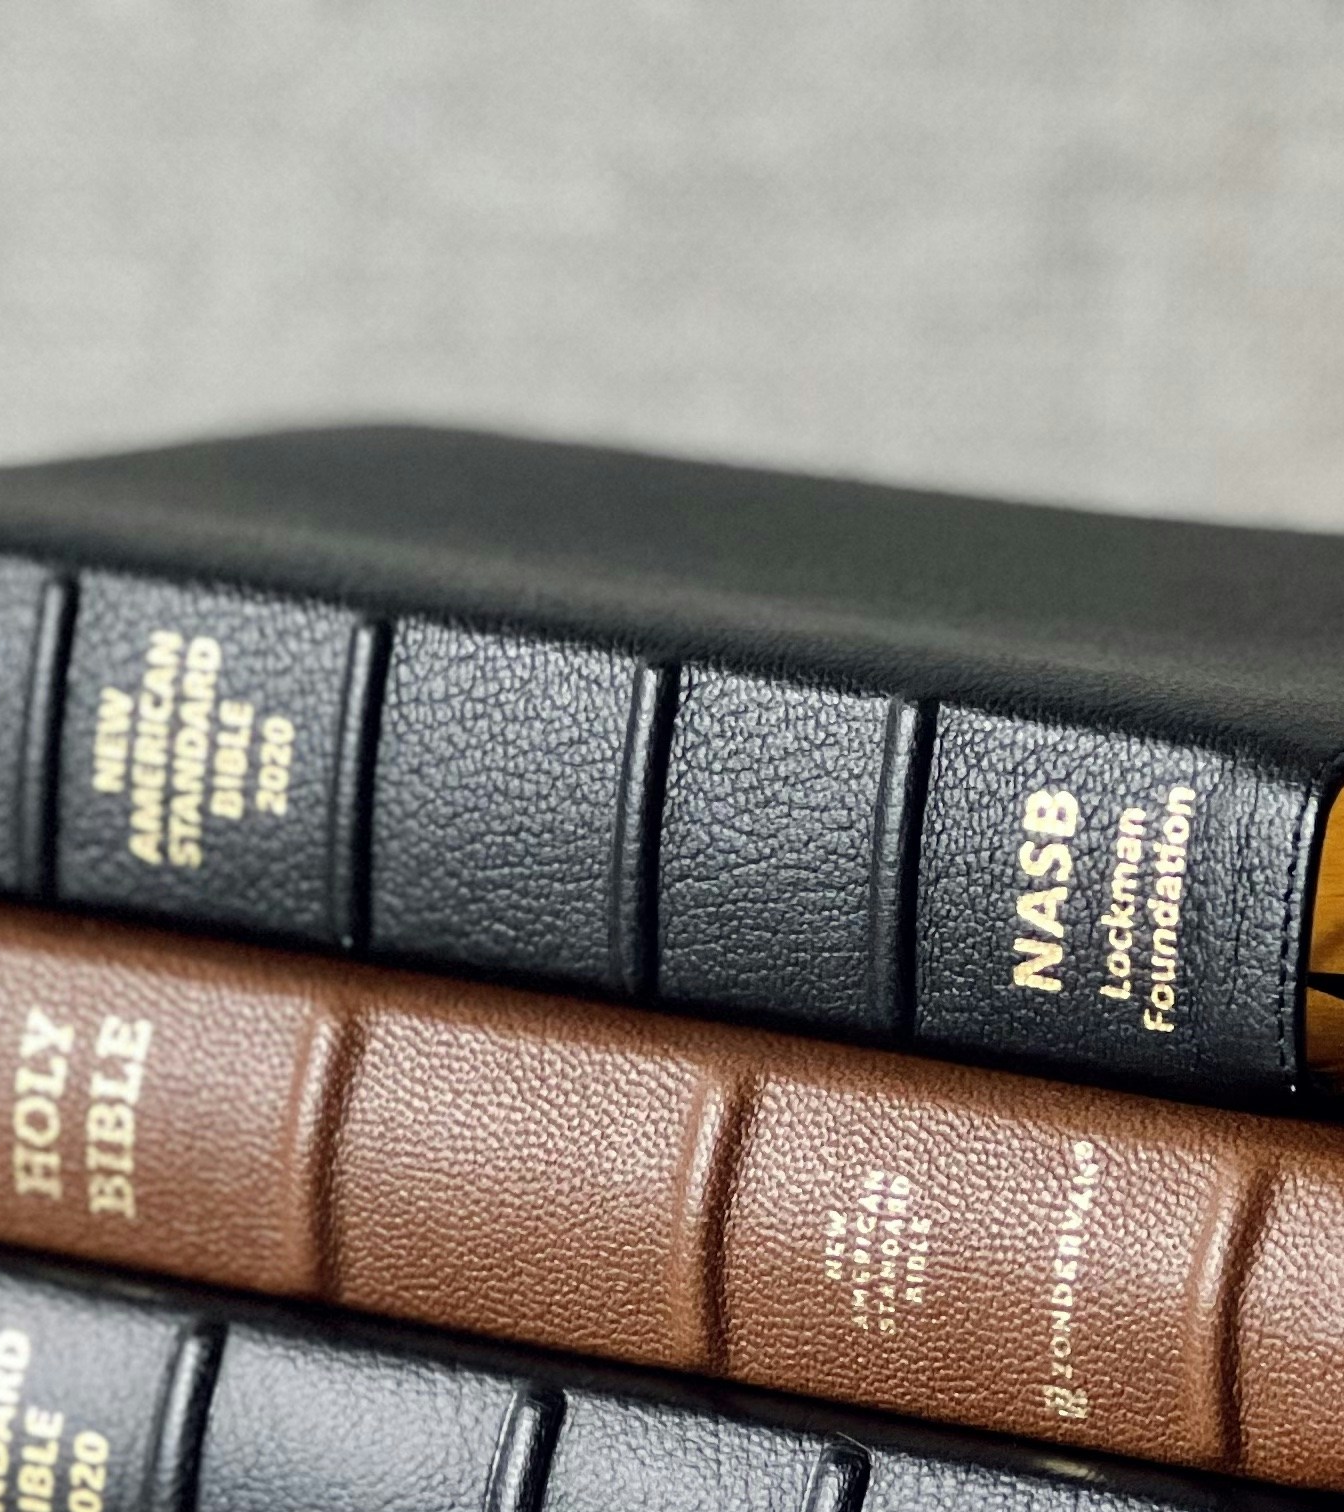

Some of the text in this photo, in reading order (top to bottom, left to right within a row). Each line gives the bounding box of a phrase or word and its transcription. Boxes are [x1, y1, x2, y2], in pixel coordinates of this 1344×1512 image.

[93, 686, 134, 793] NEW
[129, 631, 183, 864] AMERICAN
[168, 636, 222, 869] STANDARD
[210, 700, 255, 819] BIBLE
[256, 716, 296, 817] 2020
[1013, 789, 1080, 992] NASB
[1099, 807, 1147, 1000] Lockman
[1143, 785, 1196, 1033] Foundation
[12, 1004, 75, 1199] HOLY
[86, 1014, 153, 1220] BIBLE
